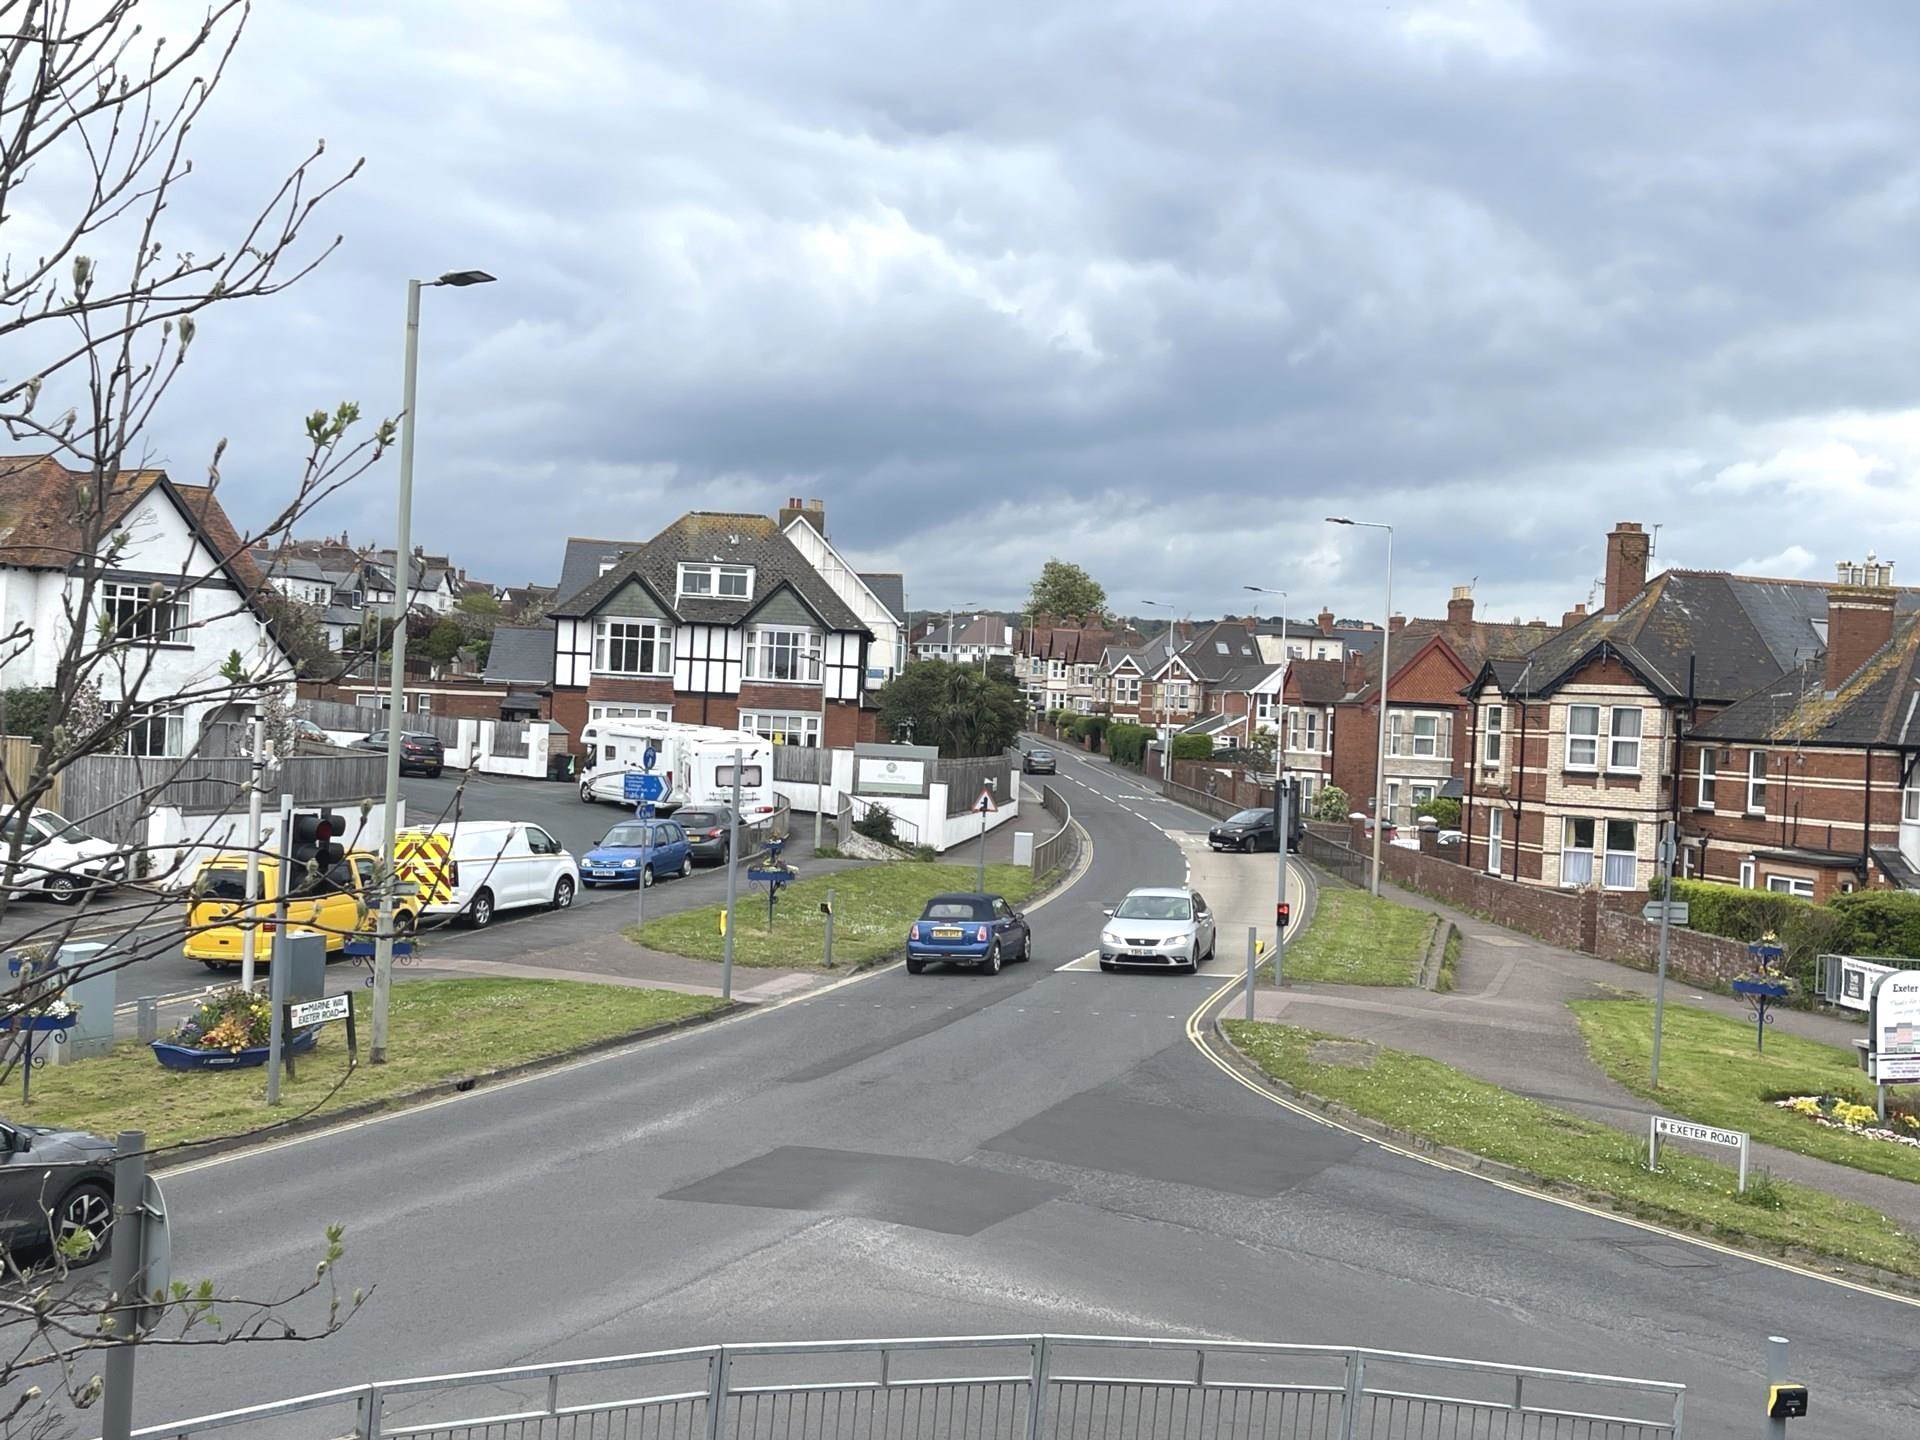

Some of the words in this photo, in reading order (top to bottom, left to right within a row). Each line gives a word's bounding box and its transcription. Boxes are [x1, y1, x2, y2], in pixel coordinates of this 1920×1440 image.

[1892, 983, 1919, 993] Exeter
[308, 1001, 330, 1012] MARINE
[332, 998, 344, 1007] WAY
[298, 1012, 320, 1024] EXETER
[322, 1008, 340, 1019] ROAD
[1670, 1123, 1707, 1138] EXETER
[1710, 1131, 1738, 1146] ROAD
